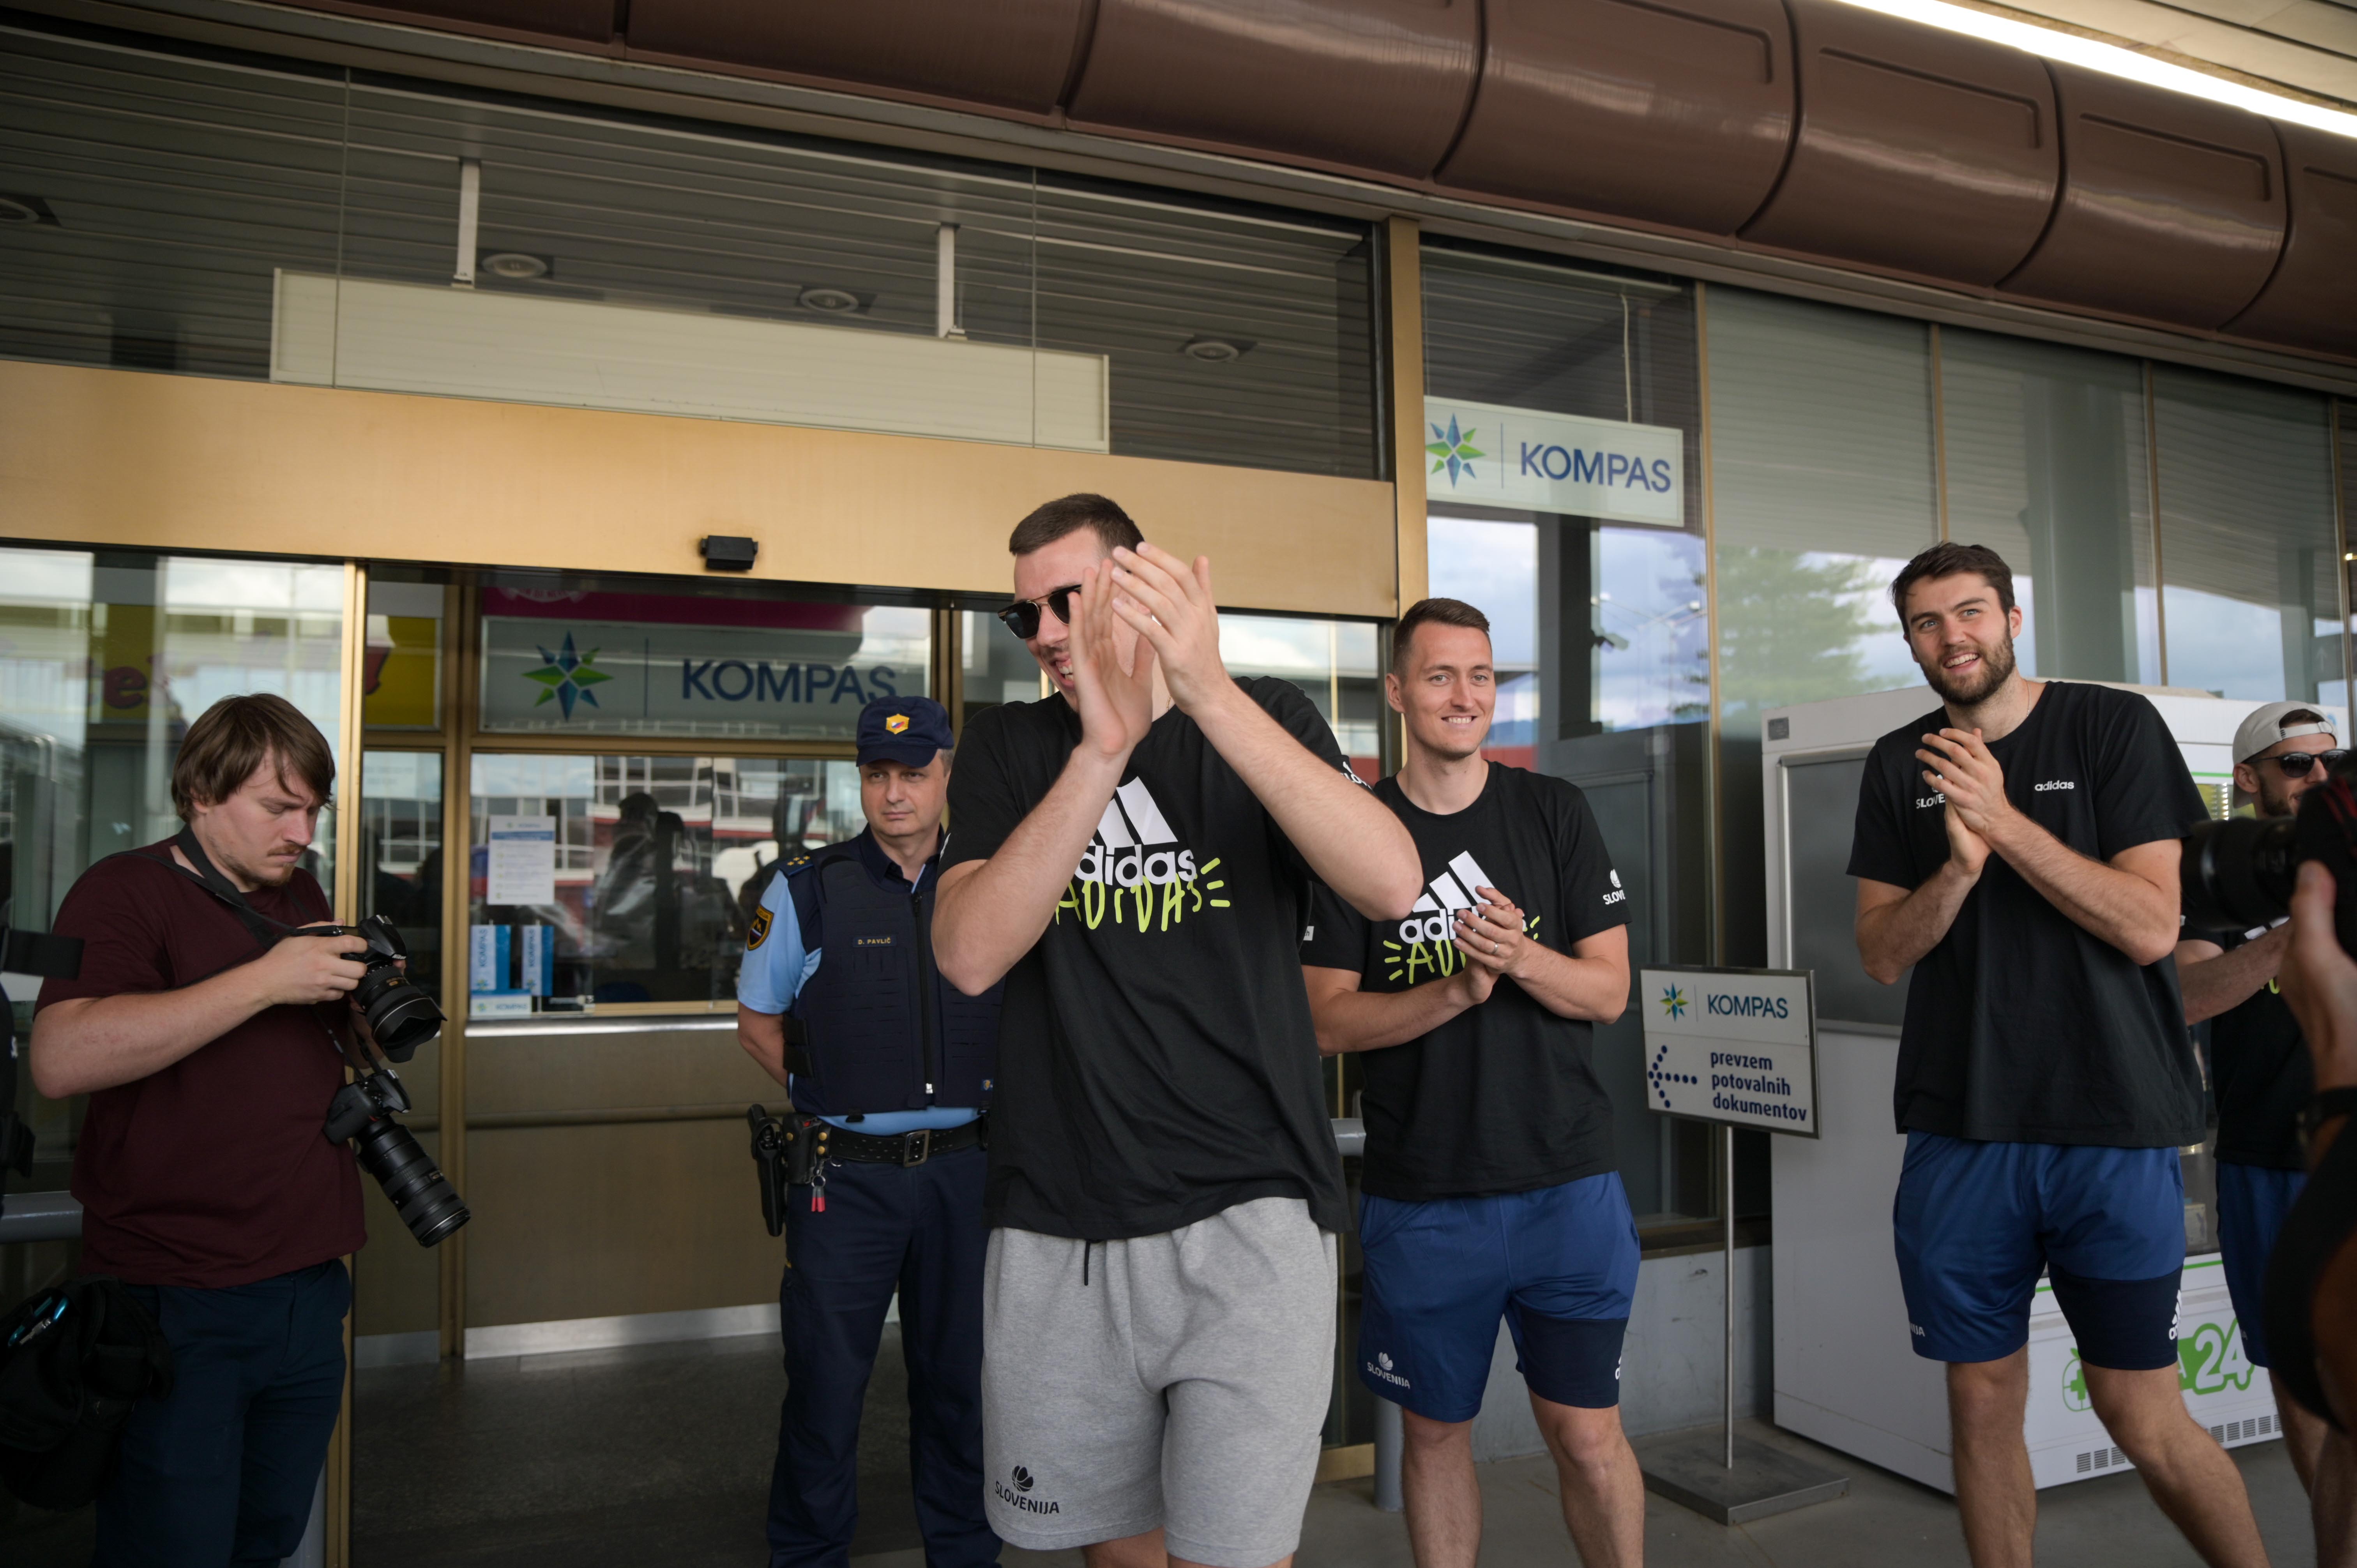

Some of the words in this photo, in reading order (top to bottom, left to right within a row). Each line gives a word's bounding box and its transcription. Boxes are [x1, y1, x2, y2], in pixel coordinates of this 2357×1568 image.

[1521, 441, 1671, 493] KOMPAS
[682, 659, 896, 704] KOMPAS
[2034, 780, 2074, 791] adidas
[1074, 844, 1196, 887] didas
[478, 929, 488, 968] KOMPAS
[1707, 994, 1789, 1019] KOMPAS
[1710, 1052, 1772, 1071] prevzem
[1711, 1074, 1791, 1096] potovalnih
[1712, 1092, 1807, 1121] dokumentov
[2195, 1322, 2252, 1390] 24
[1367, 1361, 1410, 1390] SLOVENIJA
[995, 1480, 1060, 1515] SLOVENIJA
